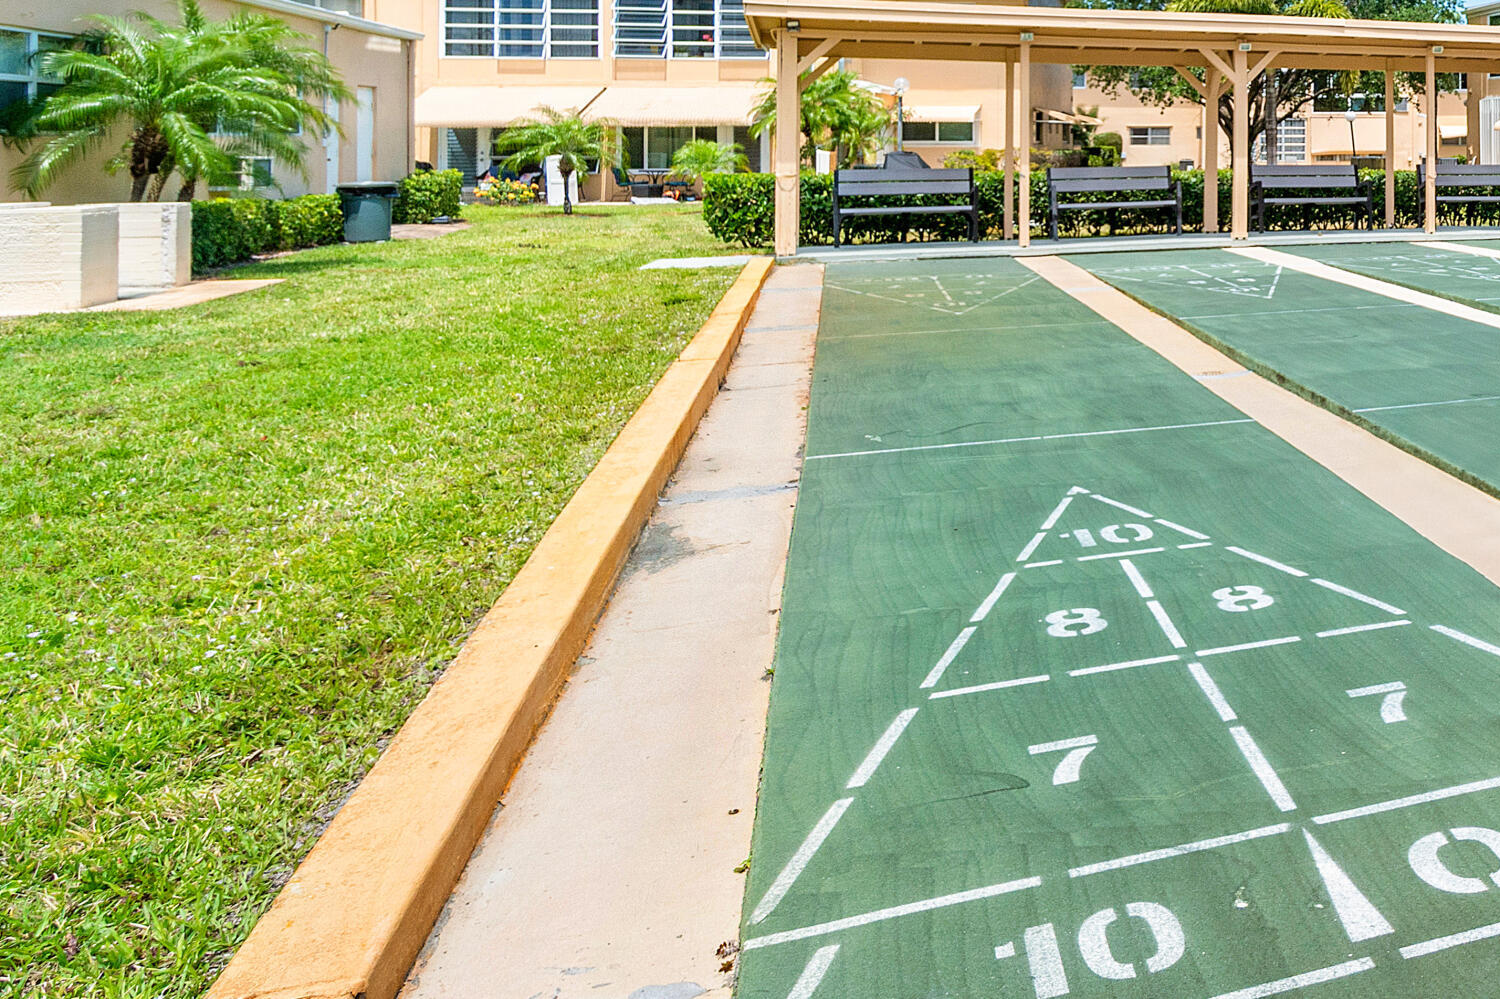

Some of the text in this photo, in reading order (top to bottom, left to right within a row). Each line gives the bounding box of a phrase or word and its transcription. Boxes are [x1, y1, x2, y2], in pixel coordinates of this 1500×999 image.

[1060, 522, 1154, 546] 10
[1044, 585, 1275, 638] 8 8
[1027, 680, 1408, 786] 7 7
[994, 901, 1186, 999] 10
